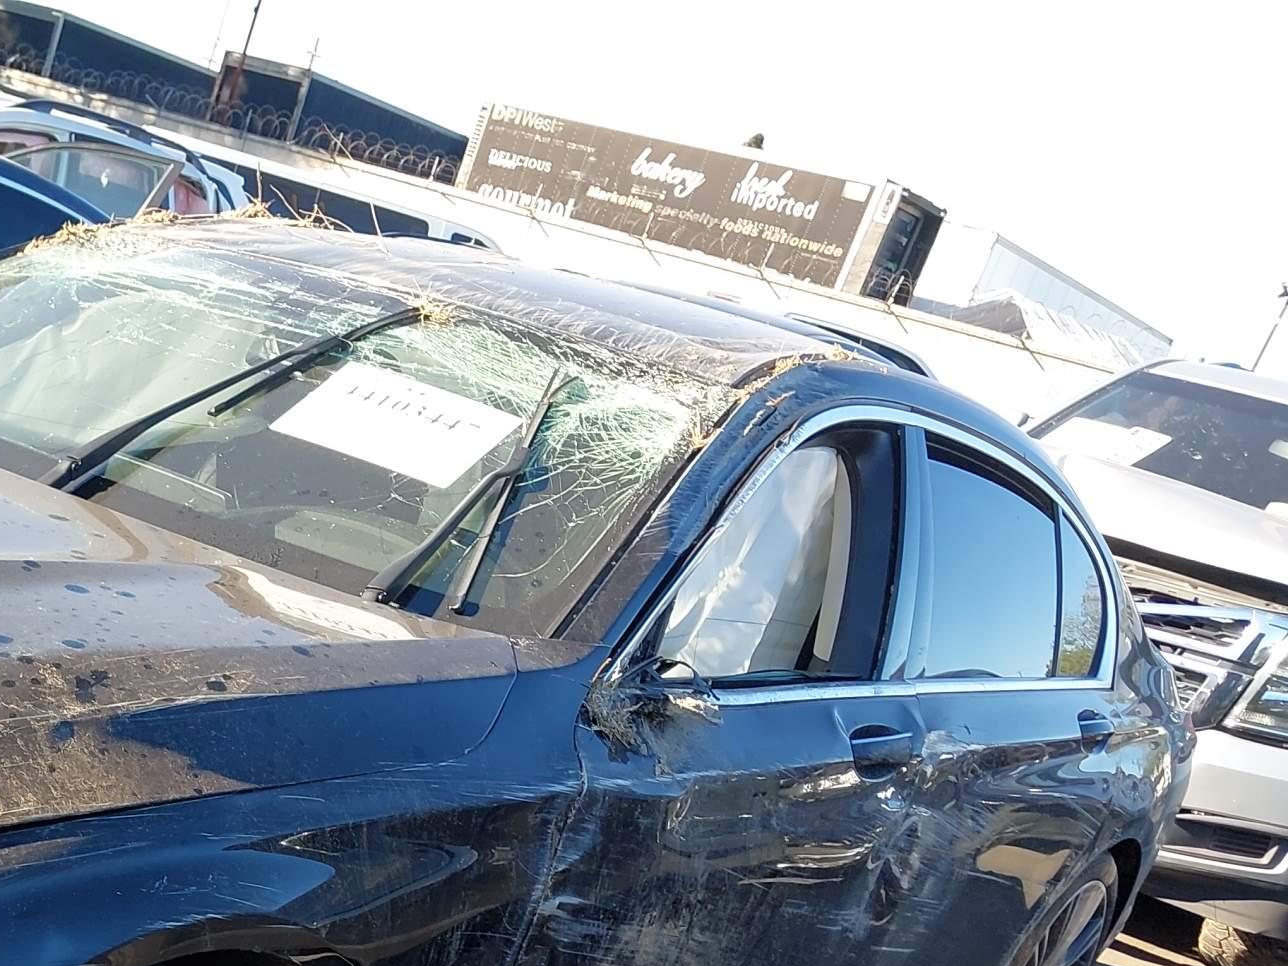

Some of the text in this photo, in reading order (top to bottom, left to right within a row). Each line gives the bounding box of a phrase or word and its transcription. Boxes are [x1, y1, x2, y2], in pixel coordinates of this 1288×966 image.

[488, 148, 552, 173] DELICIOUS
[631, 147, 706, 198] bakery
[729, 182, 820, 221] imported
